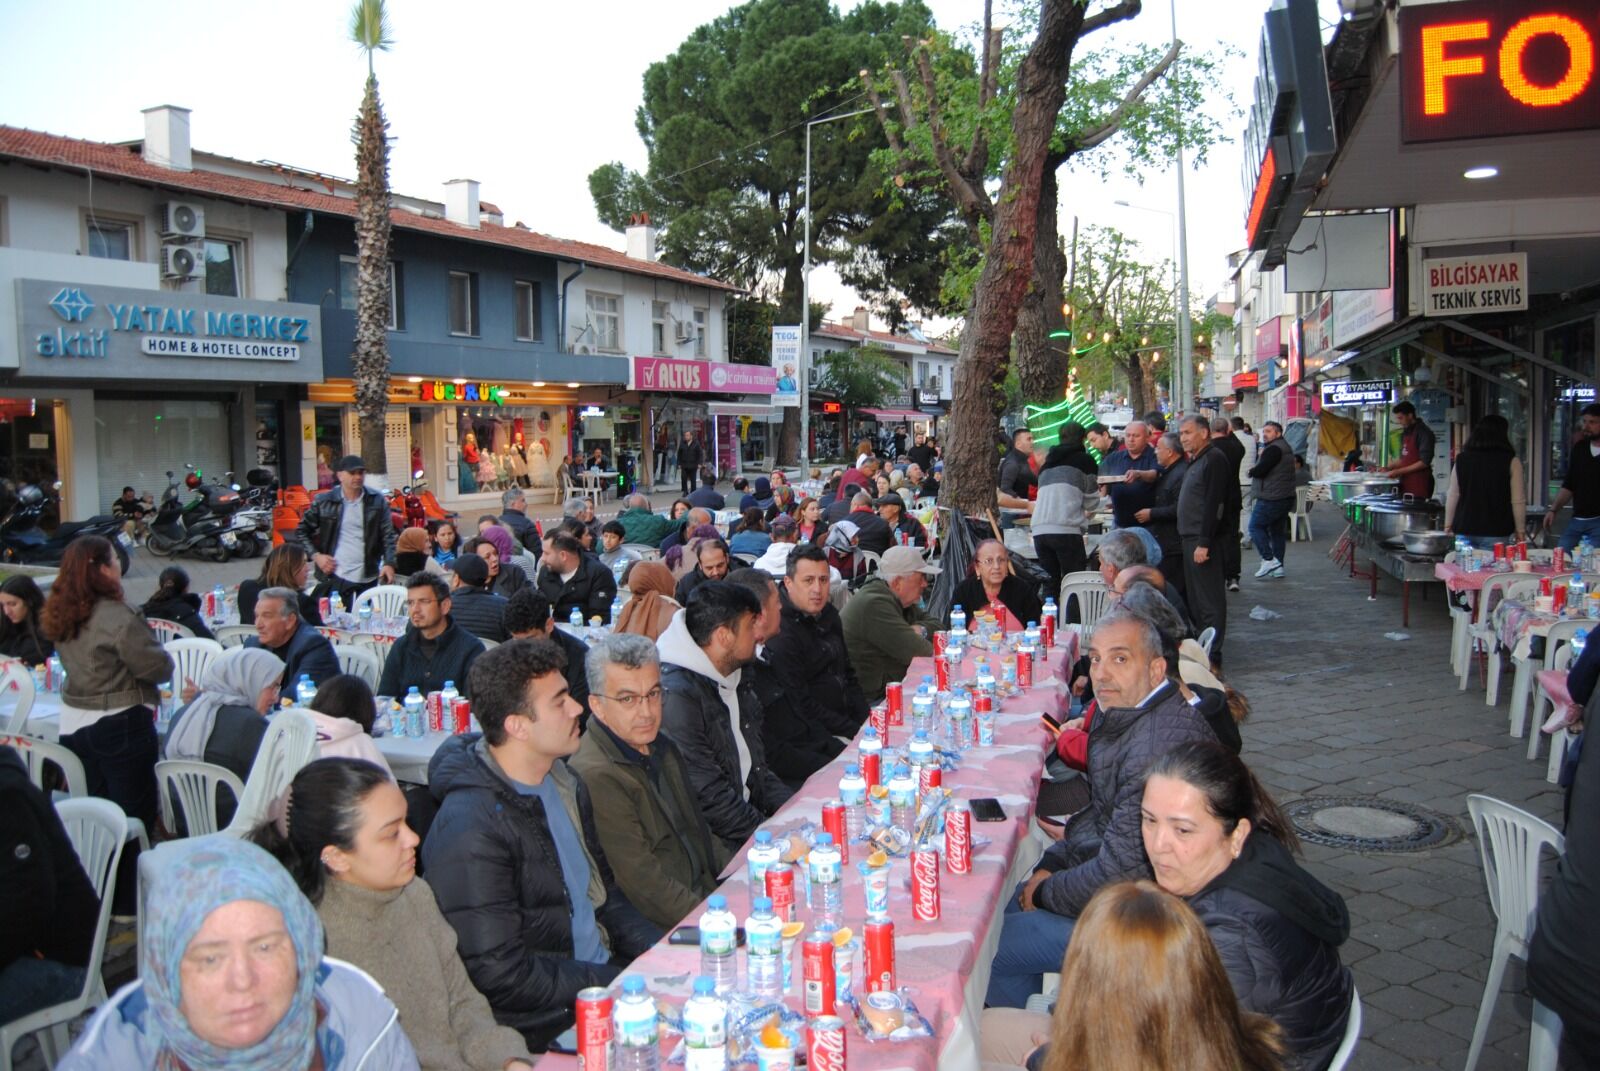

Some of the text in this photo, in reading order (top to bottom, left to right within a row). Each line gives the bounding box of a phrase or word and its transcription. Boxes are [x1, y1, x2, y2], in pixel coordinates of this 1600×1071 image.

[1421, 13, 1594, 116] FO
[1430, 262, 1520, 288] BİLGİSAYAR
[1432, 285, 1521, 310] TEKNİK SERVİS
[105, 303, 196, 335] YATAK
[36, 327, 109, 358] aktif
[148, 339, 297, 358] HOME & HOTEL CONCEPT
[658, 363, 701, 389] ALTUS
